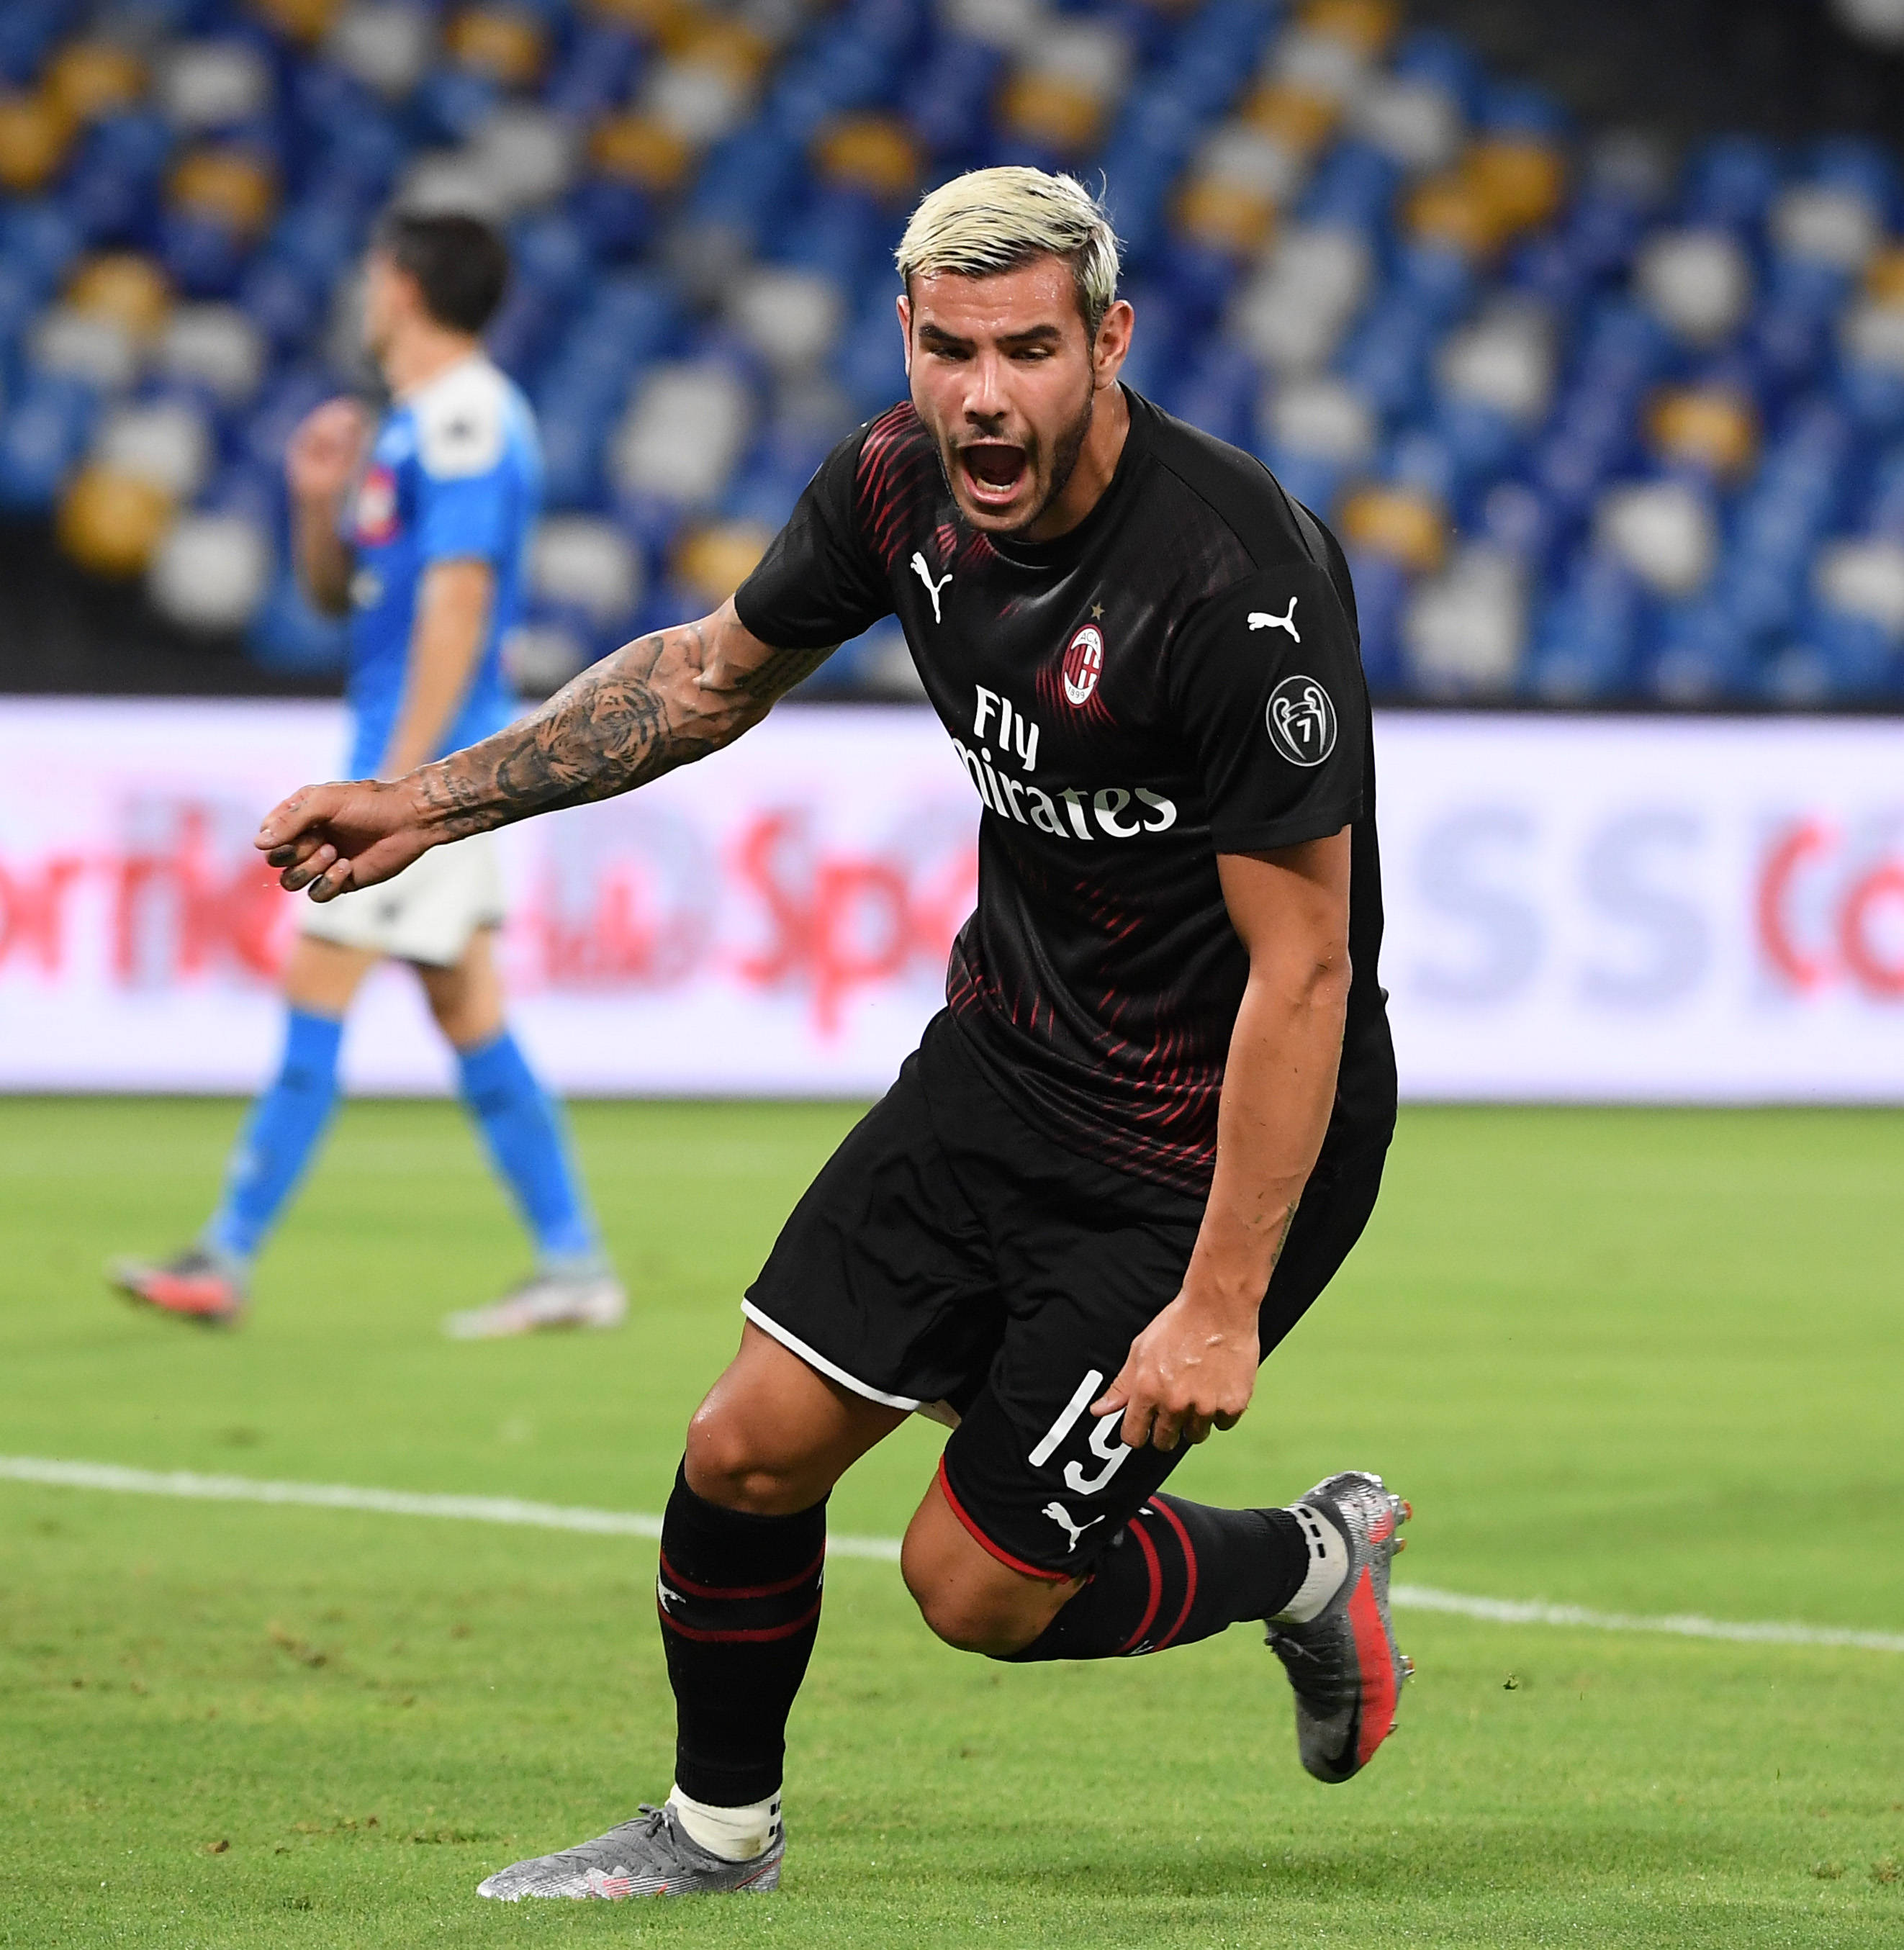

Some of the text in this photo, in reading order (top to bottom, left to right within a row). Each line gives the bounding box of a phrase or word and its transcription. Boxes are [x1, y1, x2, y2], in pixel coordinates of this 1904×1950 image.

[1068, 685, 1086, 699] 1899
[973, 684, 1039, 772] Fly
[1296, 718, 1312, 743] 7
[1027, 1369, 1134, 1496] 19
